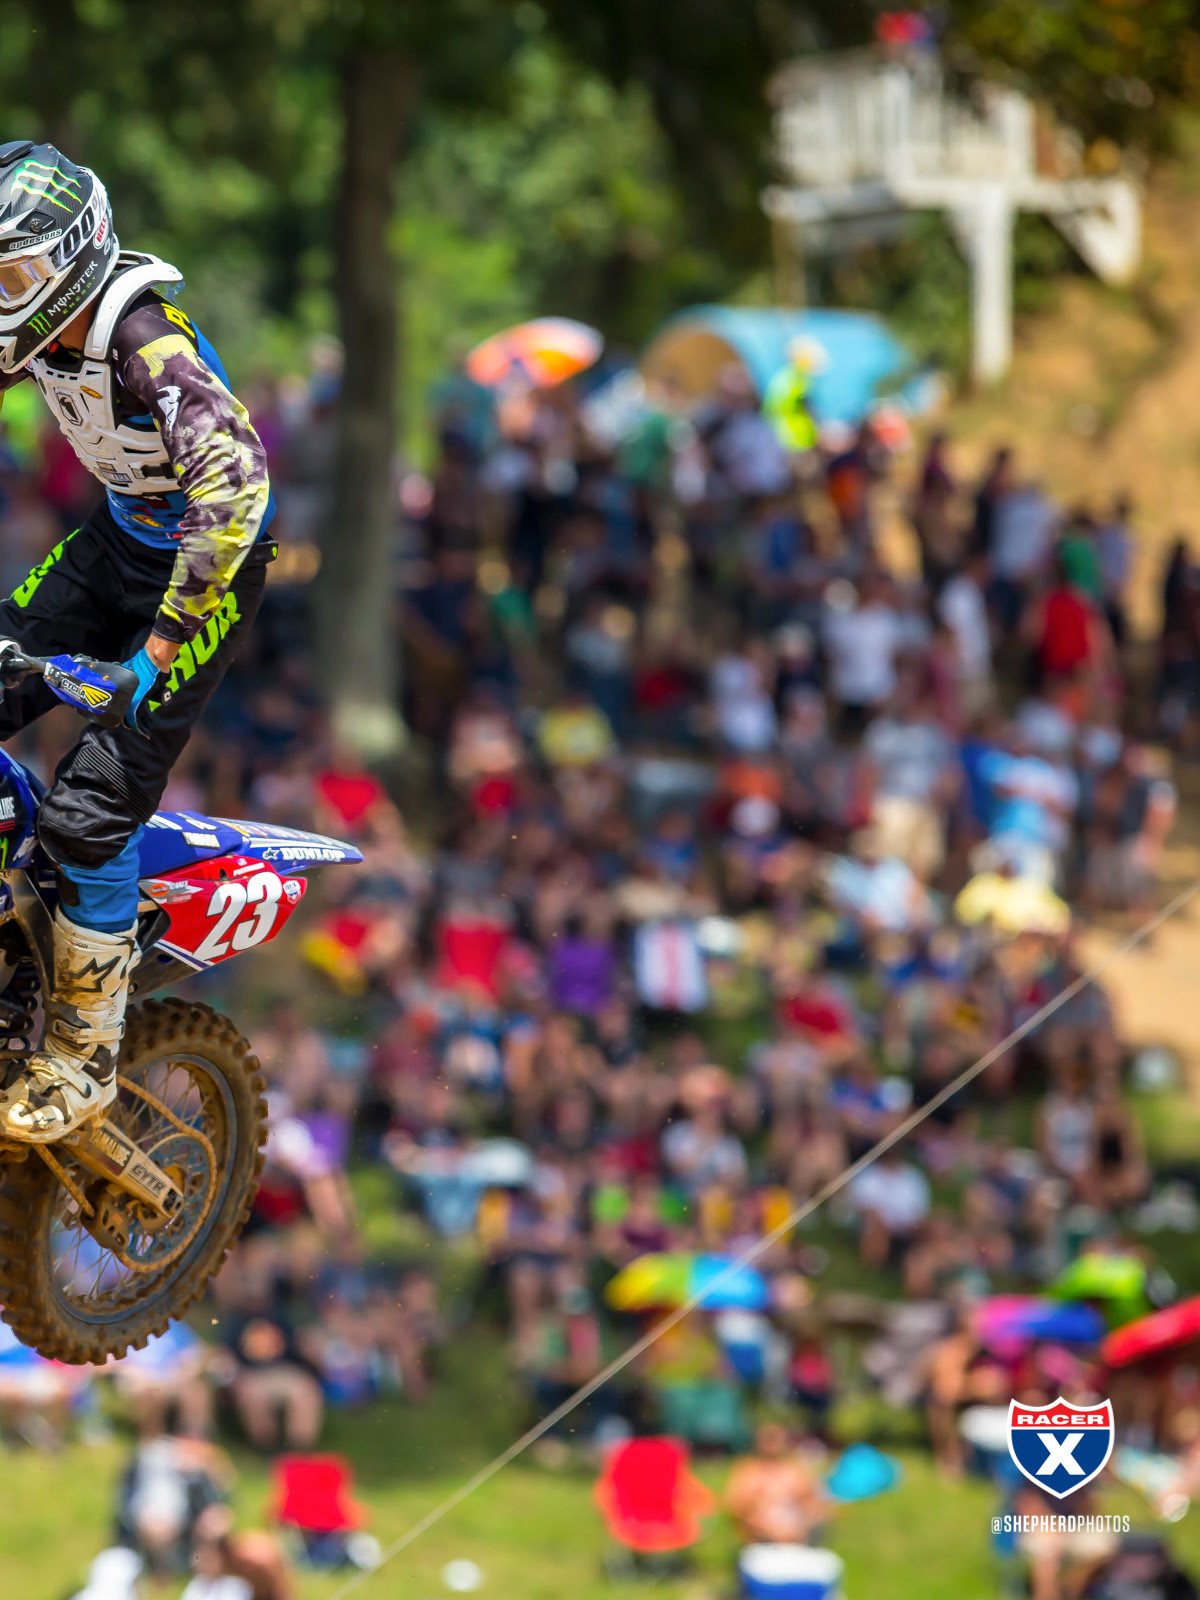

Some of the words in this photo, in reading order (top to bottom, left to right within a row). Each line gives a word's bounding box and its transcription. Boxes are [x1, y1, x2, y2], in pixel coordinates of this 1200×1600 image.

[95, 217, 108, 243] BELL
[47, 260, 99, 317] MONSTER
[62, 275, 97, 315] ENERGY
[62, 678, 86, 698] CYCRA
[280, 847, 346, 863] DUNLOP
[191, 871, 284, 962] 23
[131, 1163, 168, 1192] GYTR
